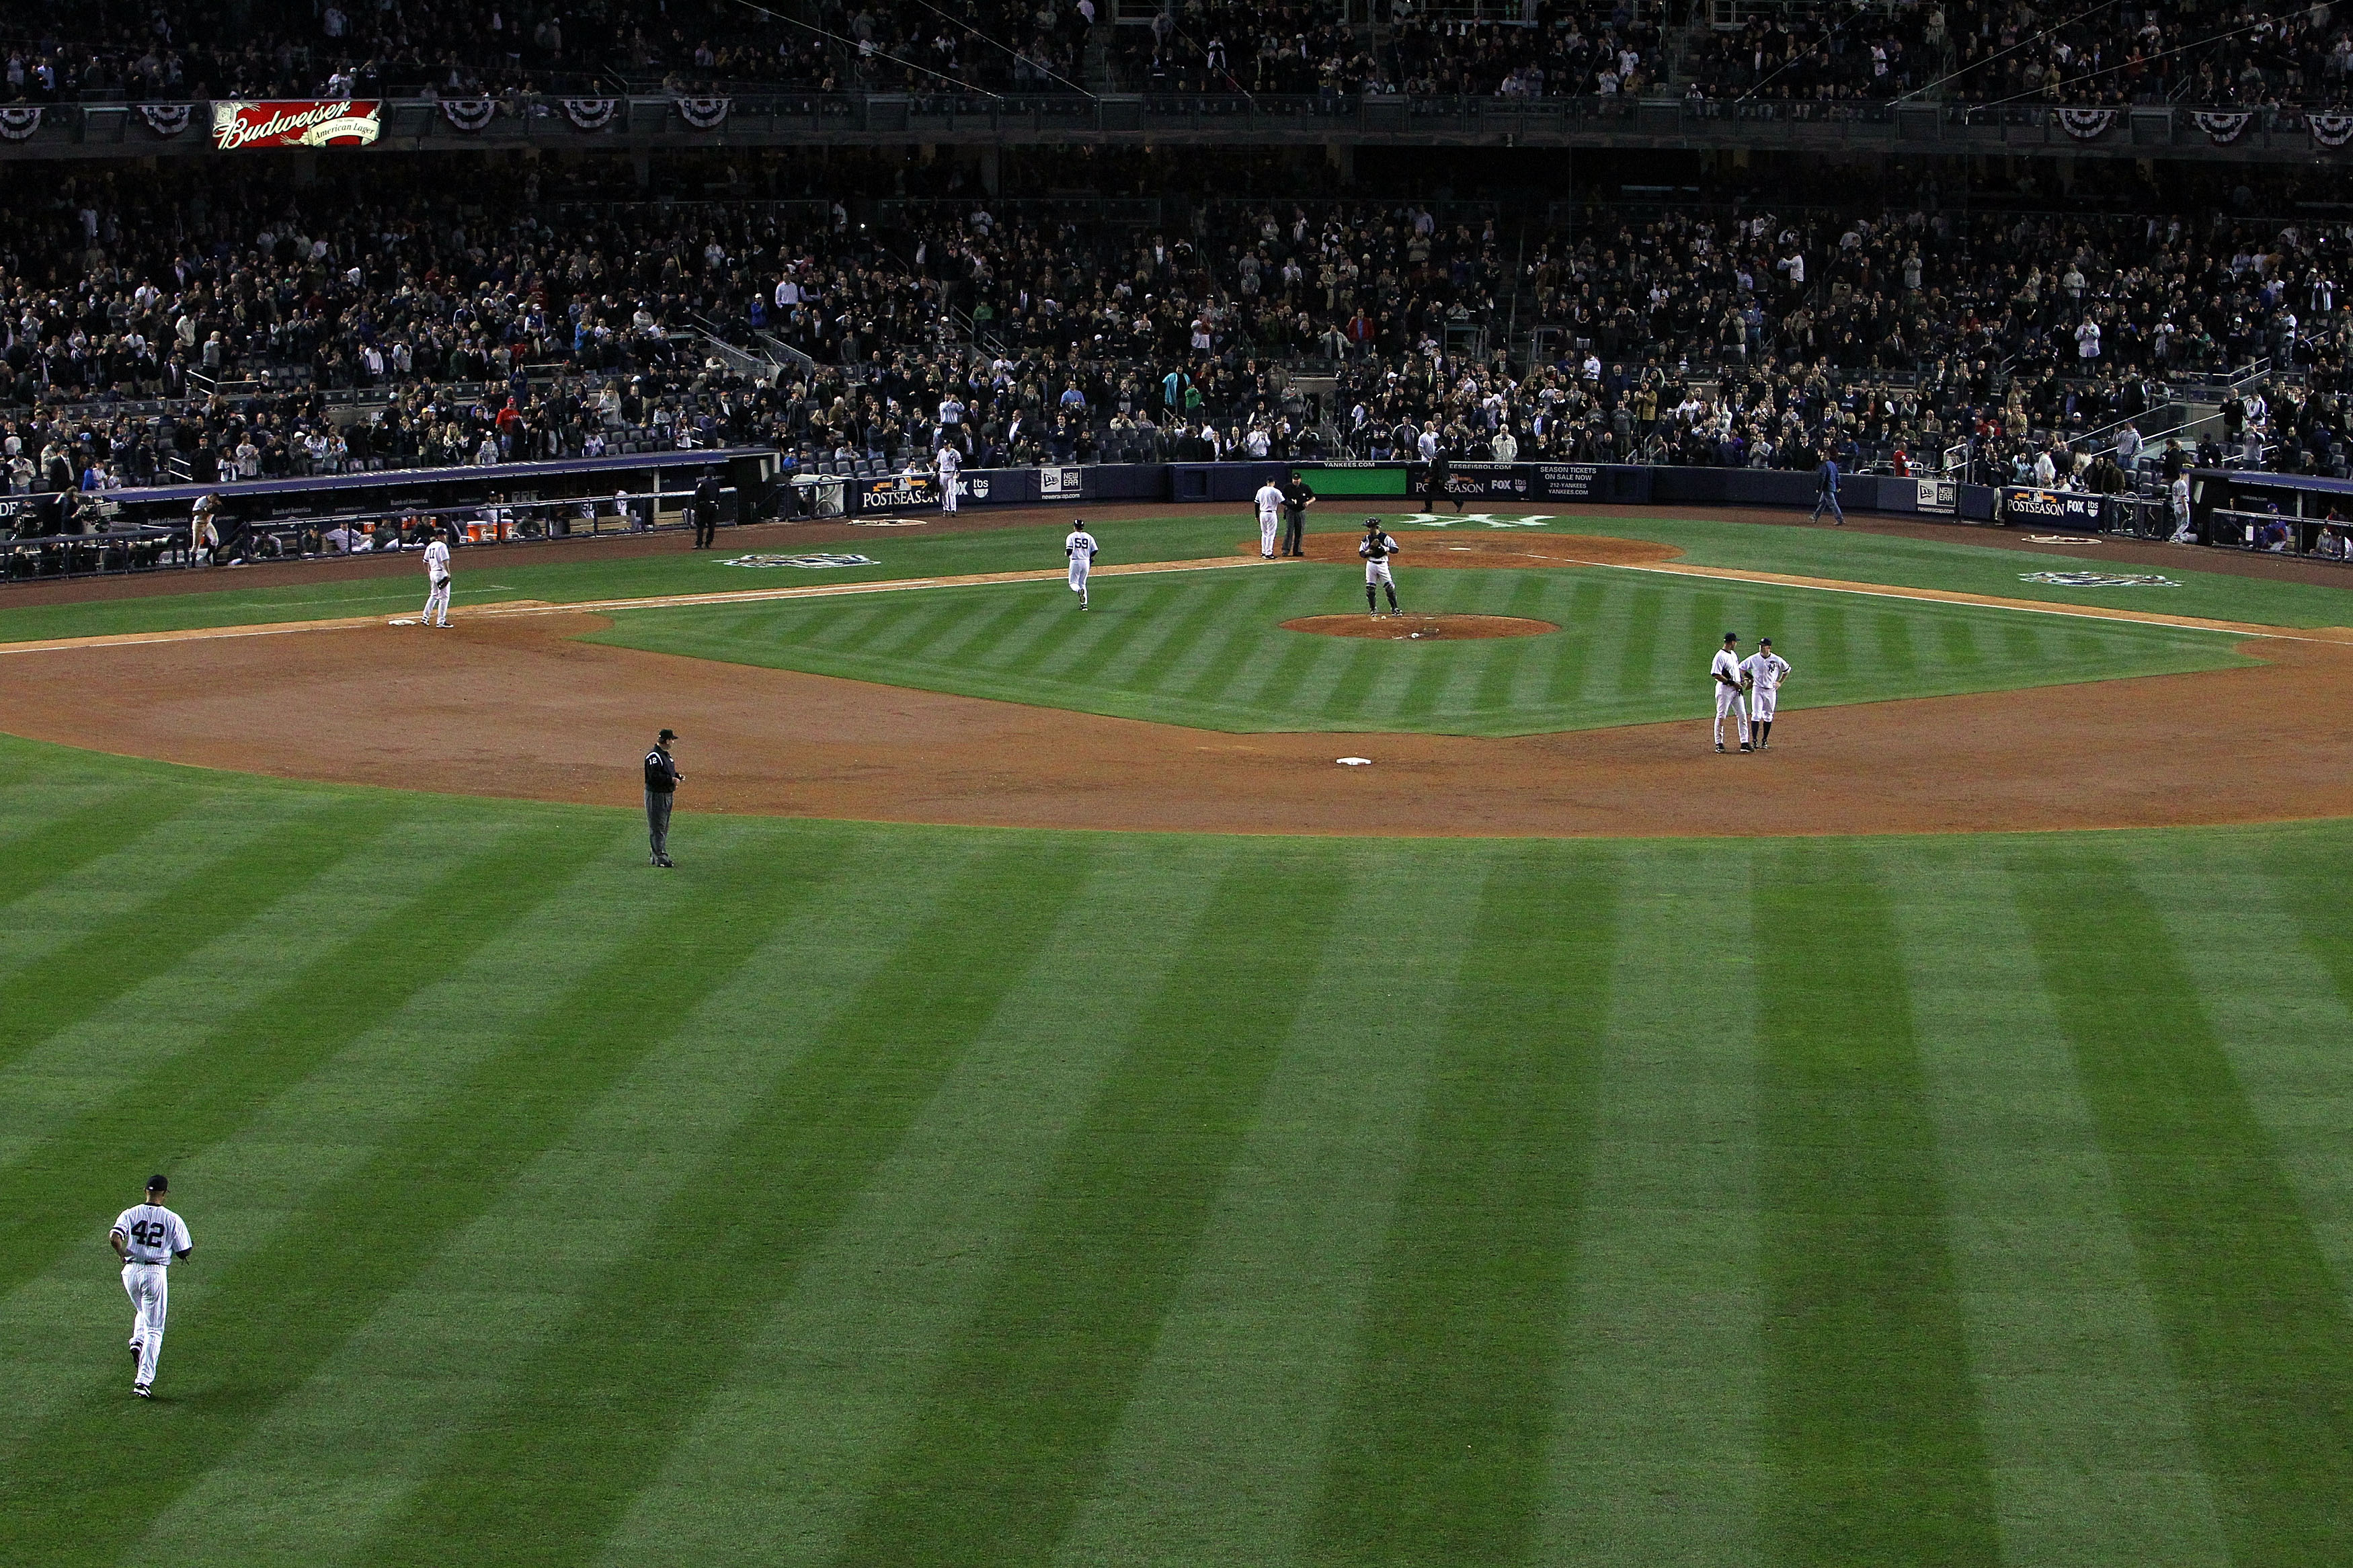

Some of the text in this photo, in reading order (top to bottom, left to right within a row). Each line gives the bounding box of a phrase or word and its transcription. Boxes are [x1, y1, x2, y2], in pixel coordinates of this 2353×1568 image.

[212, 101, 351, 150] Budweiser
[314, 123, 374, 140] American Lager
[973, 479, 988, 488] tbs
[1415, 482, 1484, 493] POEASON
[1491, 480, 1511, 489] FOX
[2007, 499, 2065, 517] POSTSEASON
[2067, 500, 2085, 513] FOX
[2087, 500, 2099, 509] tbs
[1075, 538, 1088, 549] 59
[430, 548, 435, 559] 17
[131, 1220, 165, 1248] 42
